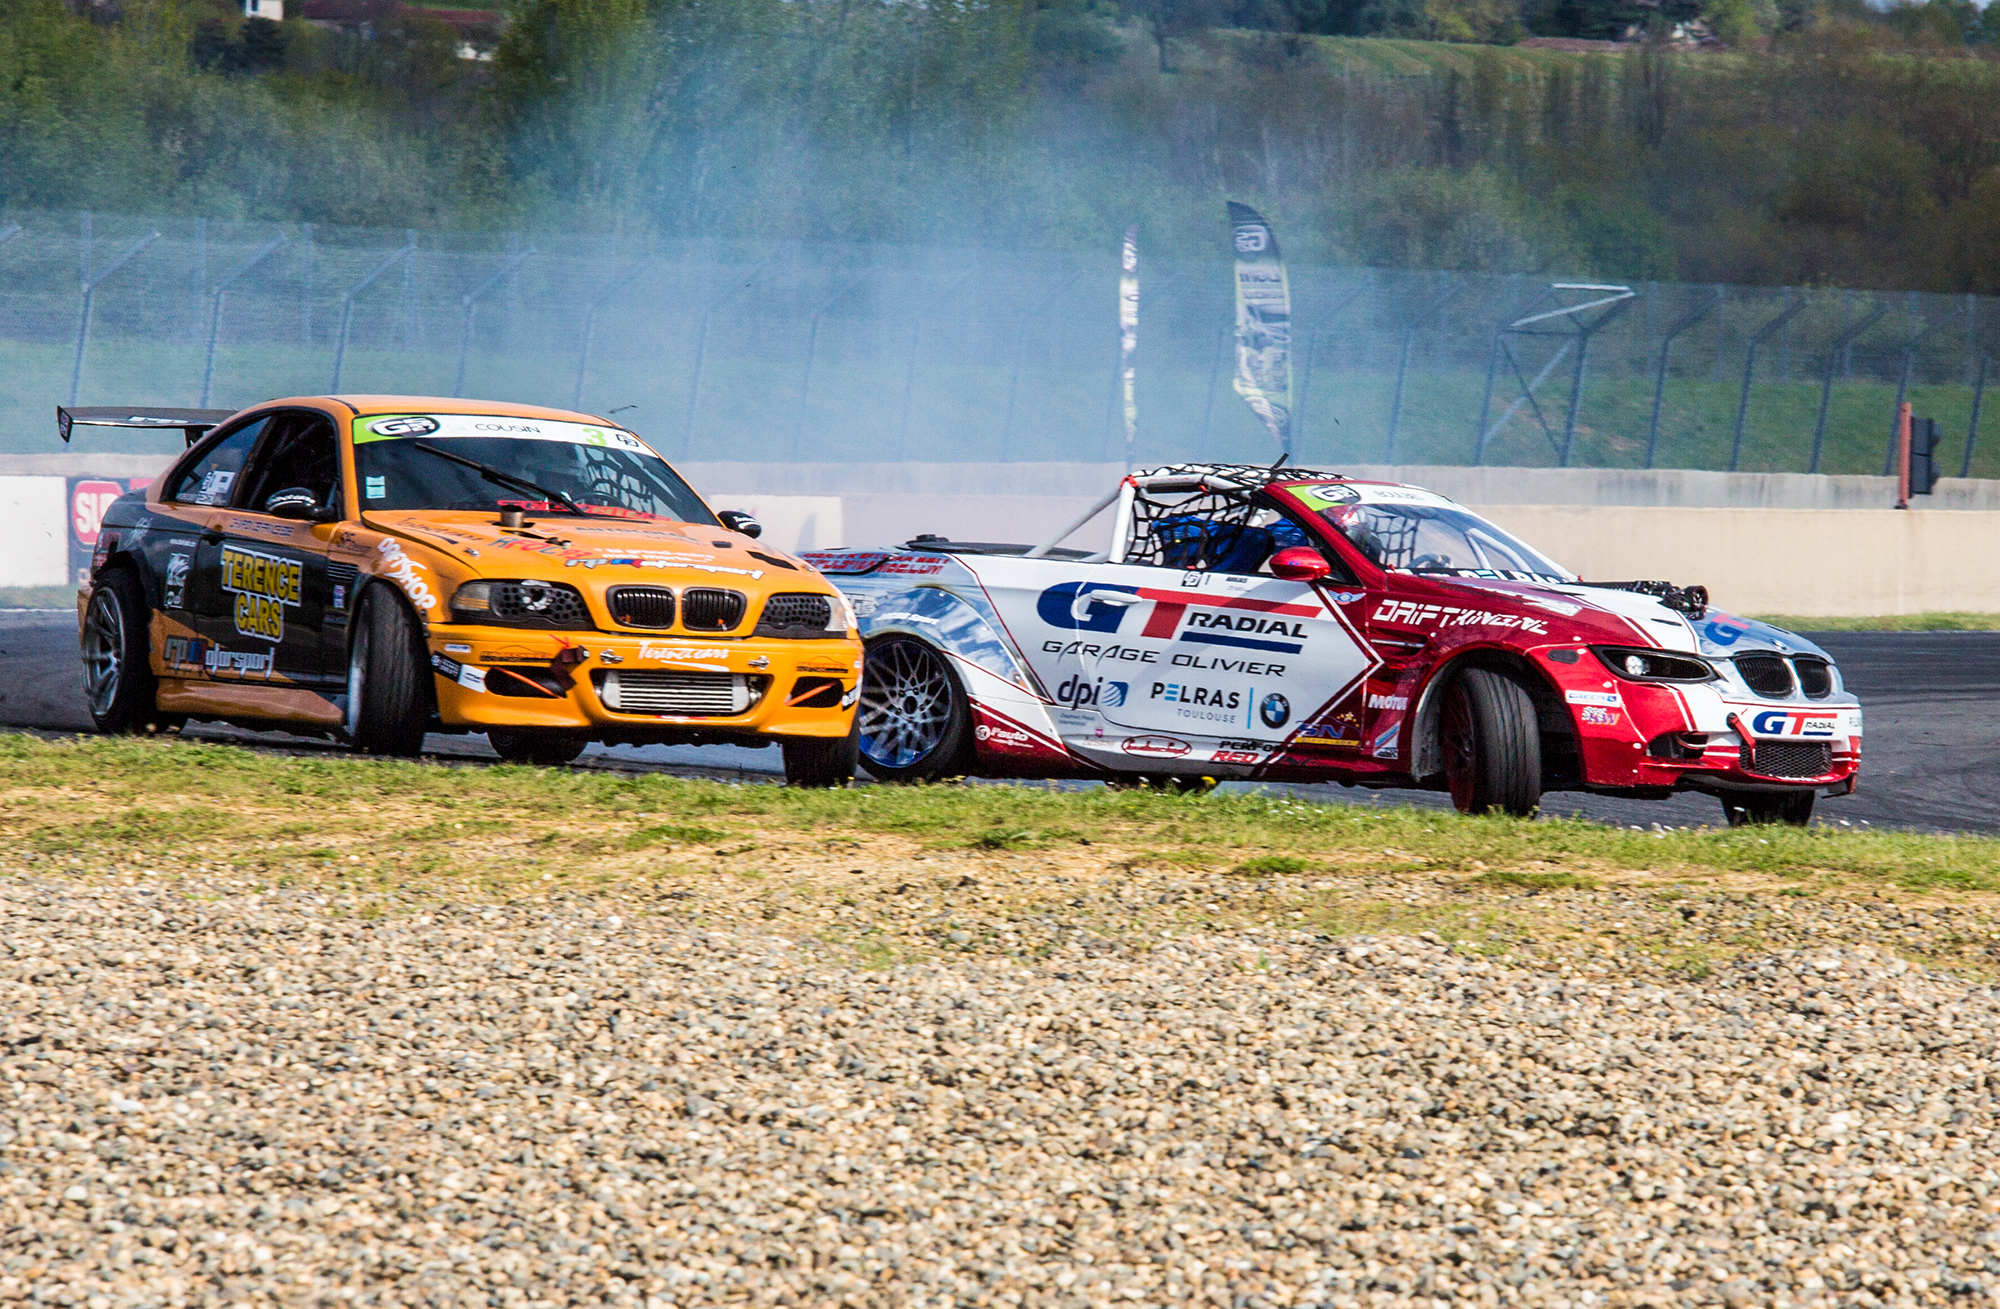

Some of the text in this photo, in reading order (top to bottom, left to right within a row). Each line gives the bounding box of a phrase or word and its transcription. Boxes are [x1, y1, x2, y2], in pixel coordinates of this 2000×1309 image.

[474, 423, 541, 434] COUSIN
[582, 427, 608, 447] 3
[221, 547, 303, 604] TERENCE
[235, 593, 283, 639] CARS
[1187, 611, 1309, 639] RADIAL
[1042, 640, 1286, 677] GARAGE OLIVIER
[1057, 674, 1104, 711] dpi
[1150, 682, 1241, 709] PELRAS
[1177, 708, 1237, 724] TOULOUSE
[1752, 708, 1837, 735] GT
[1805, 720, 1836, 729] RADIAL
[1210, 751, 1259, 764] RED
